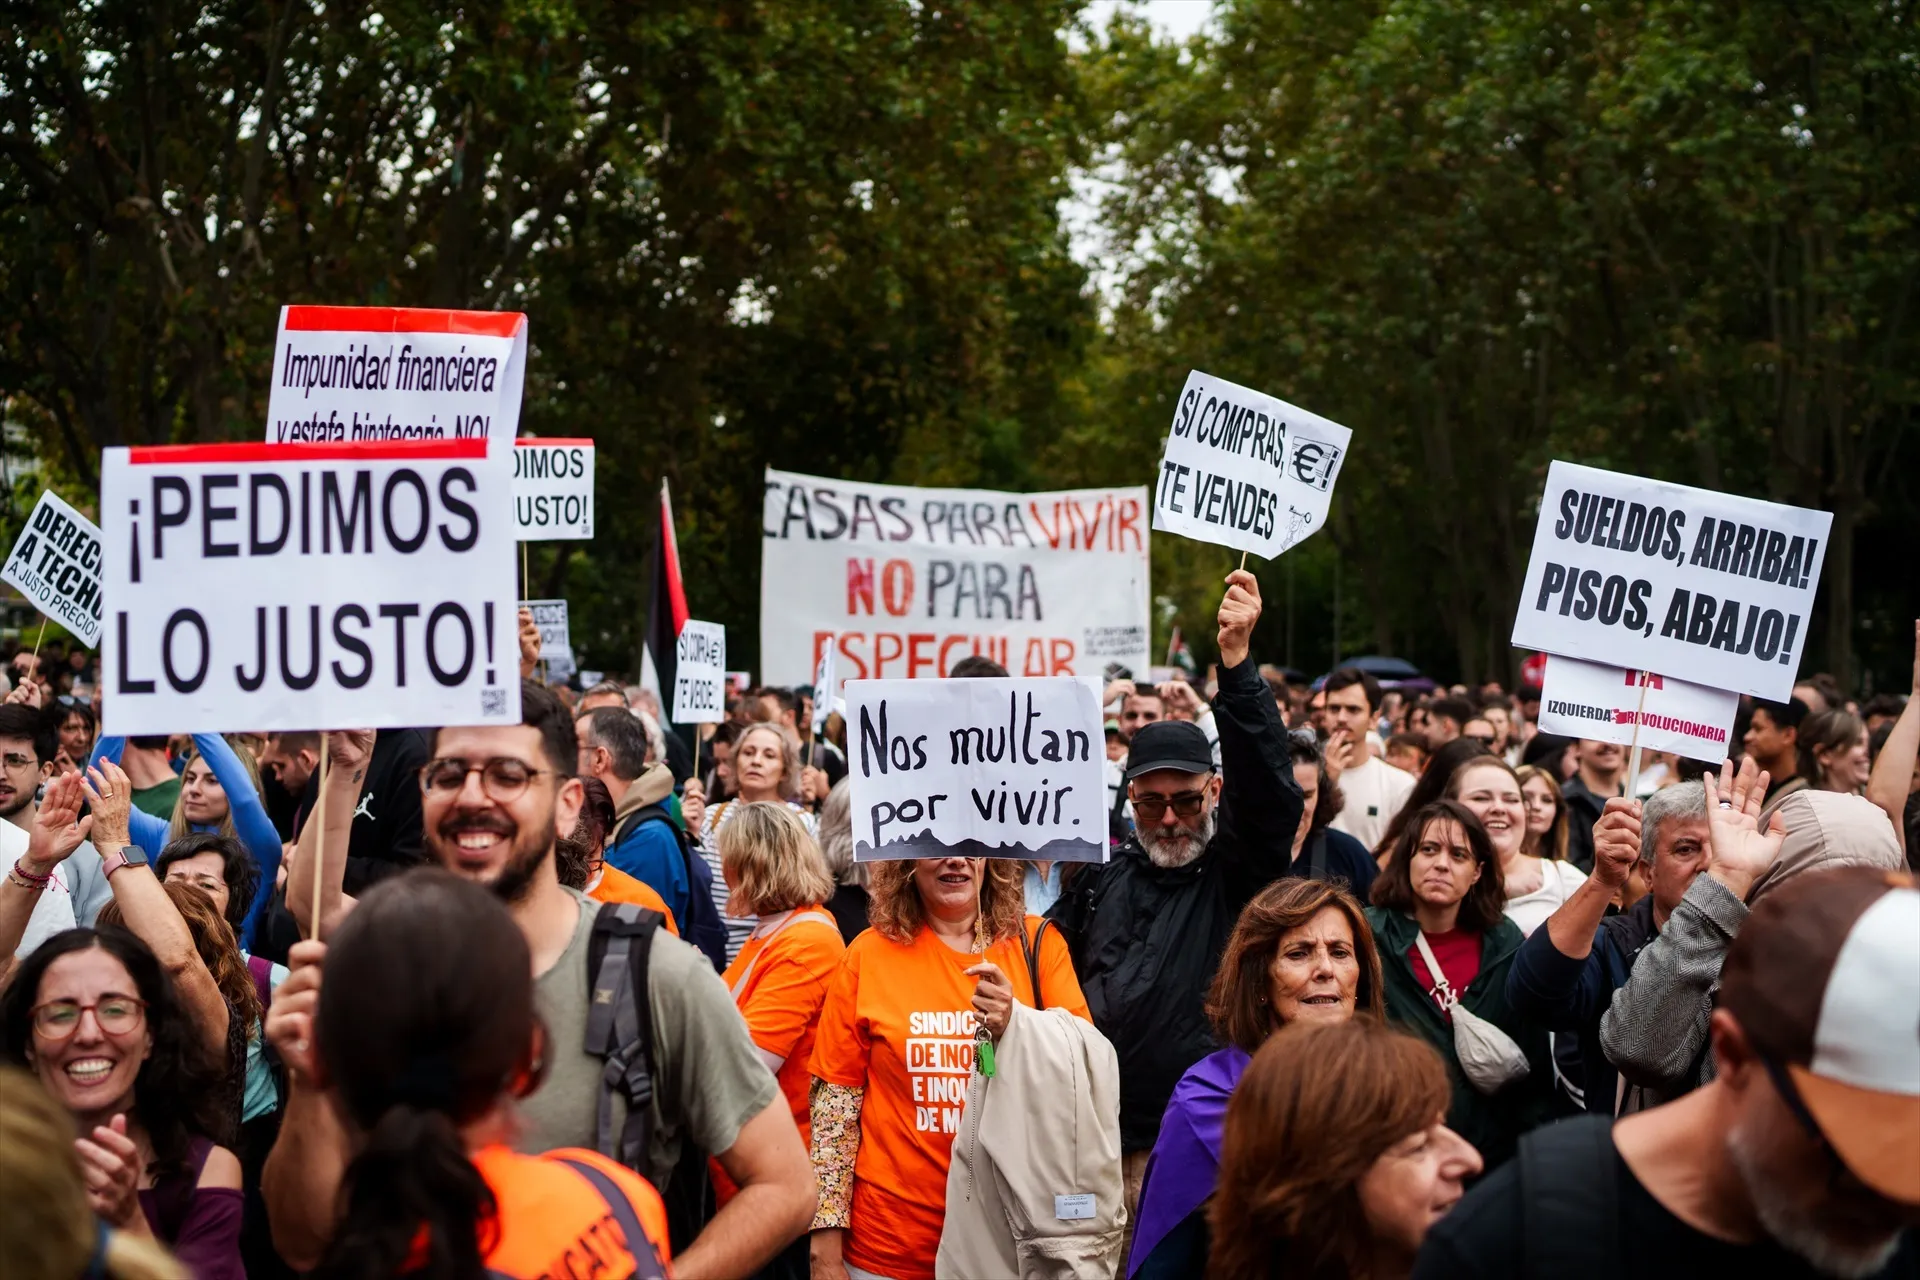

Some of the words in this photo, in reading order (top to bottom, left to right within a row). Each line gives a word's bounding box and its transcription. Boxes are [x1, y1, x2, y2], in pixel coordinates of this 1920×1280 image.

[282, 343, 394, 399] Impunidad
[395, 344, 498, 393] financiera
[1196, 396, 1287, 479] COMPRAS,
[128, 466, 481, 584] ¡PEDIMOS
[514, 494, 588, 526] USTO!
[923, 500, 1036, 548] PARA
[1030, 494, 1143, 553] VIVIR
[1160, 460, 1190, 514] TE
[1193, 470, 1278, 541] VENDES
[16, 532, 39, 565] A
[33, 502, 103, 582] DEREC
[1555, 489, 1687, 567] SUELDOS,
[1690, 516, 1819, 590] ARRIBA!
[8, 561, 20, 577] A
[19, 568, 51, 602] JUSTO
[49, 594, 99, 640] PRECIO!
[847, 557, 915, 617] NO
[927, 559, 1043, 621] PARA
[1535, 561, 1654, 638] PISOS,
[1660, 587, 1801, 666] ABAJO!
[117, 607, 211, 695] LO
[234, 601, 496, 692] JUSTO!
[860, 699, 928, 778] Nos
[949, 690, 1090, 766] multan
[1547, 699, 1612, 723] IZQUIERDA
[871, 794, 948, 848] por
[971, 778, 1081, 826] vivir.
[909, 1010, 978, 1036] SINDIC
[911, 1042, 936, 1068] DE
[940, 1043, 977, 1072] INQ
[912, 1076, 924, 1102] E
[916, 1105, 940, 1133] DE
[942, 1107, 961, 1134] M
